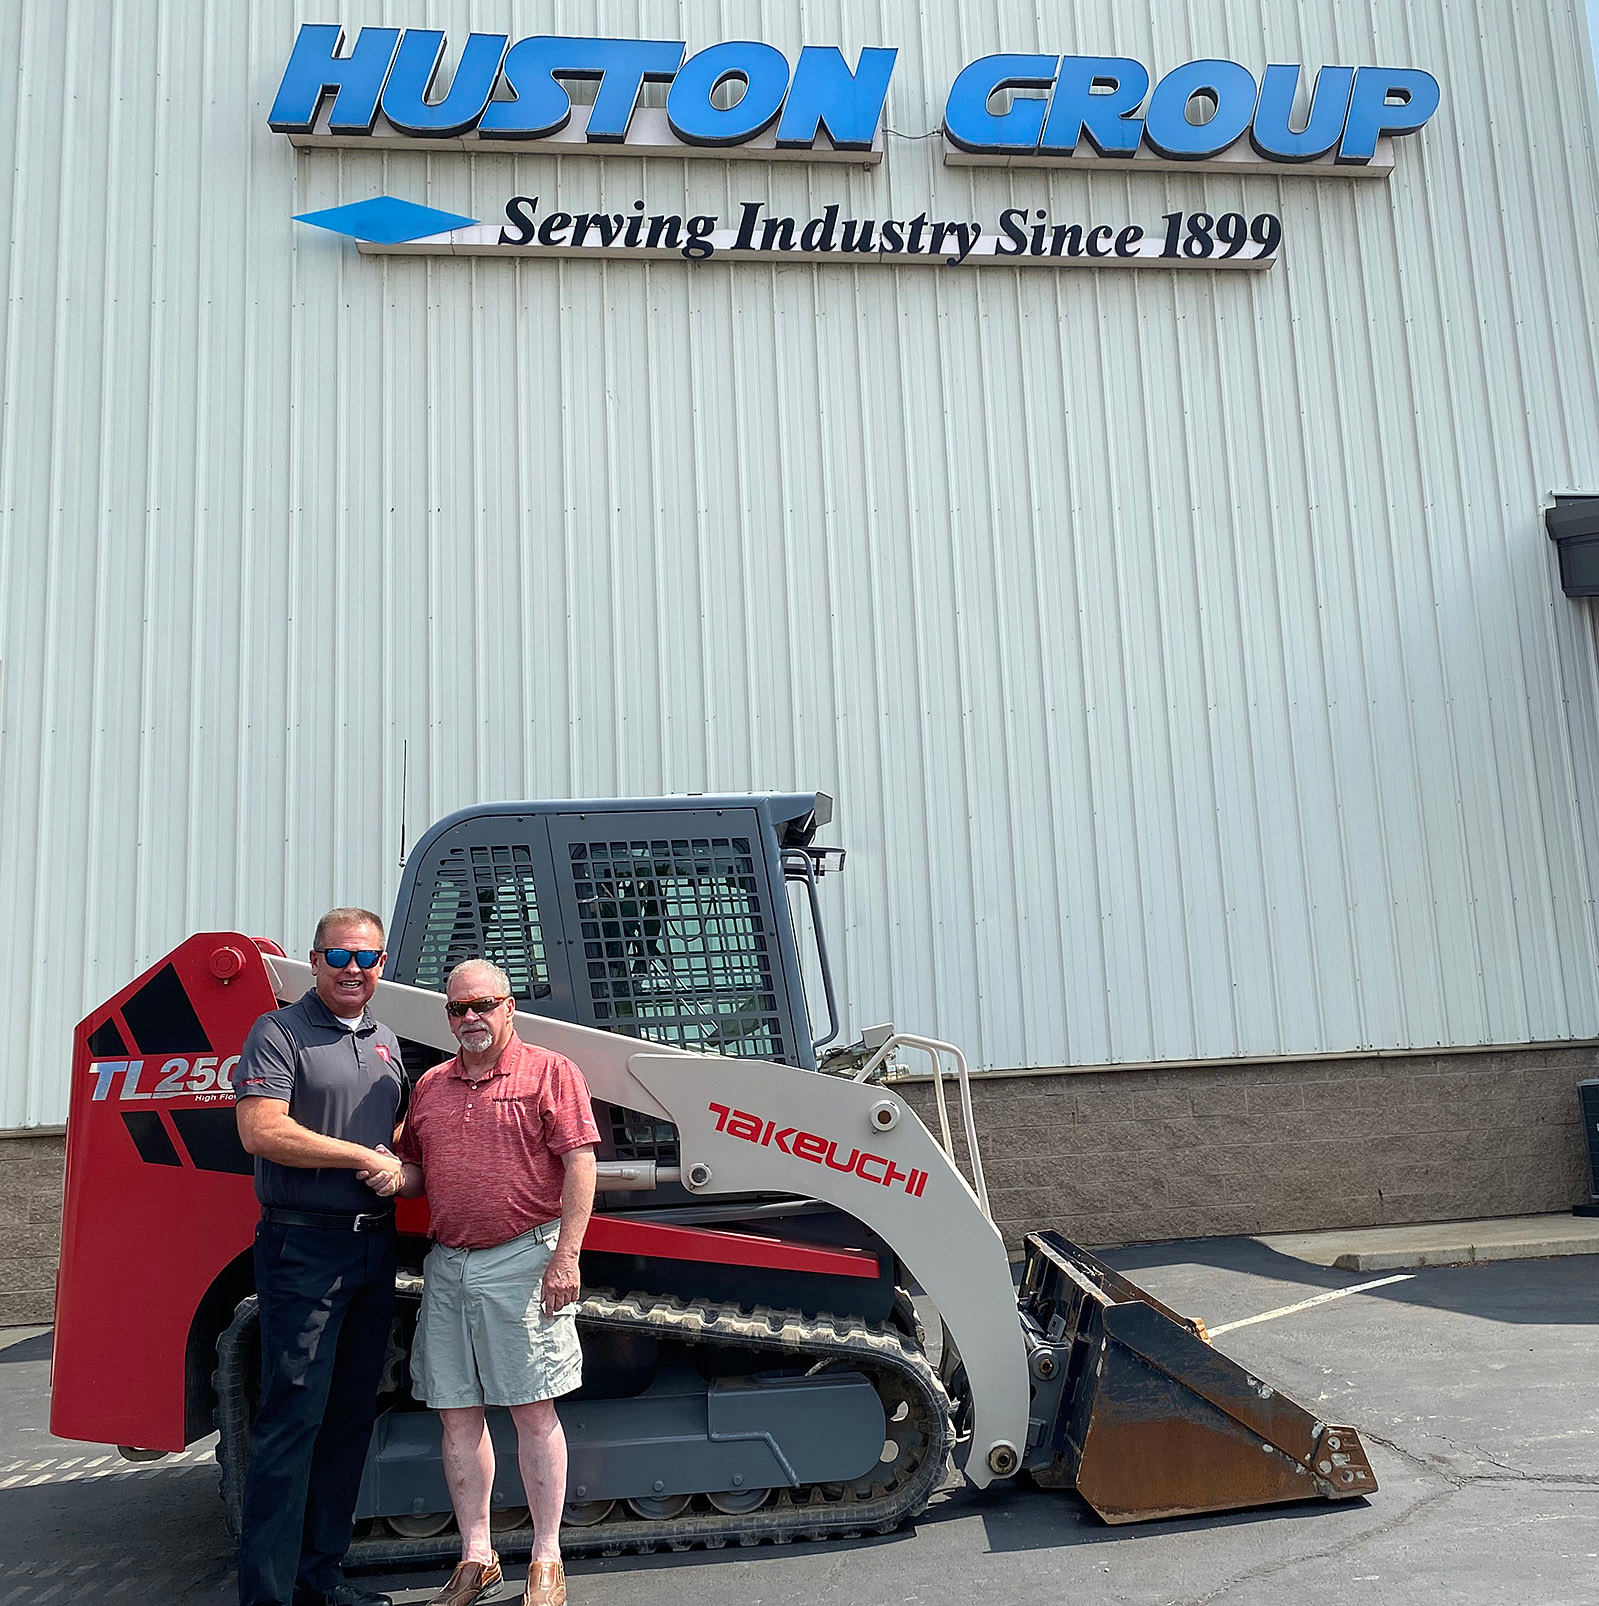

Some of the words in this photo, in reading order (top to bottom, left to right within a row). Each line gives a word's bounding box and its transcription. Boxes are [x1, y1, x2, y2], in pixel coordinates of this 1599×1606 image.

[266, 22, 899, 149] HUSTON
[943, 52, 1441, 166] GROUP
[499, 195, 719, 260] Serving
[730, 200, 982, 266] Industry
[995, 207, 1143, 259] Since
[1160, 210, 1282, 261] 1899
[194, 1094, 217, 1103] High
